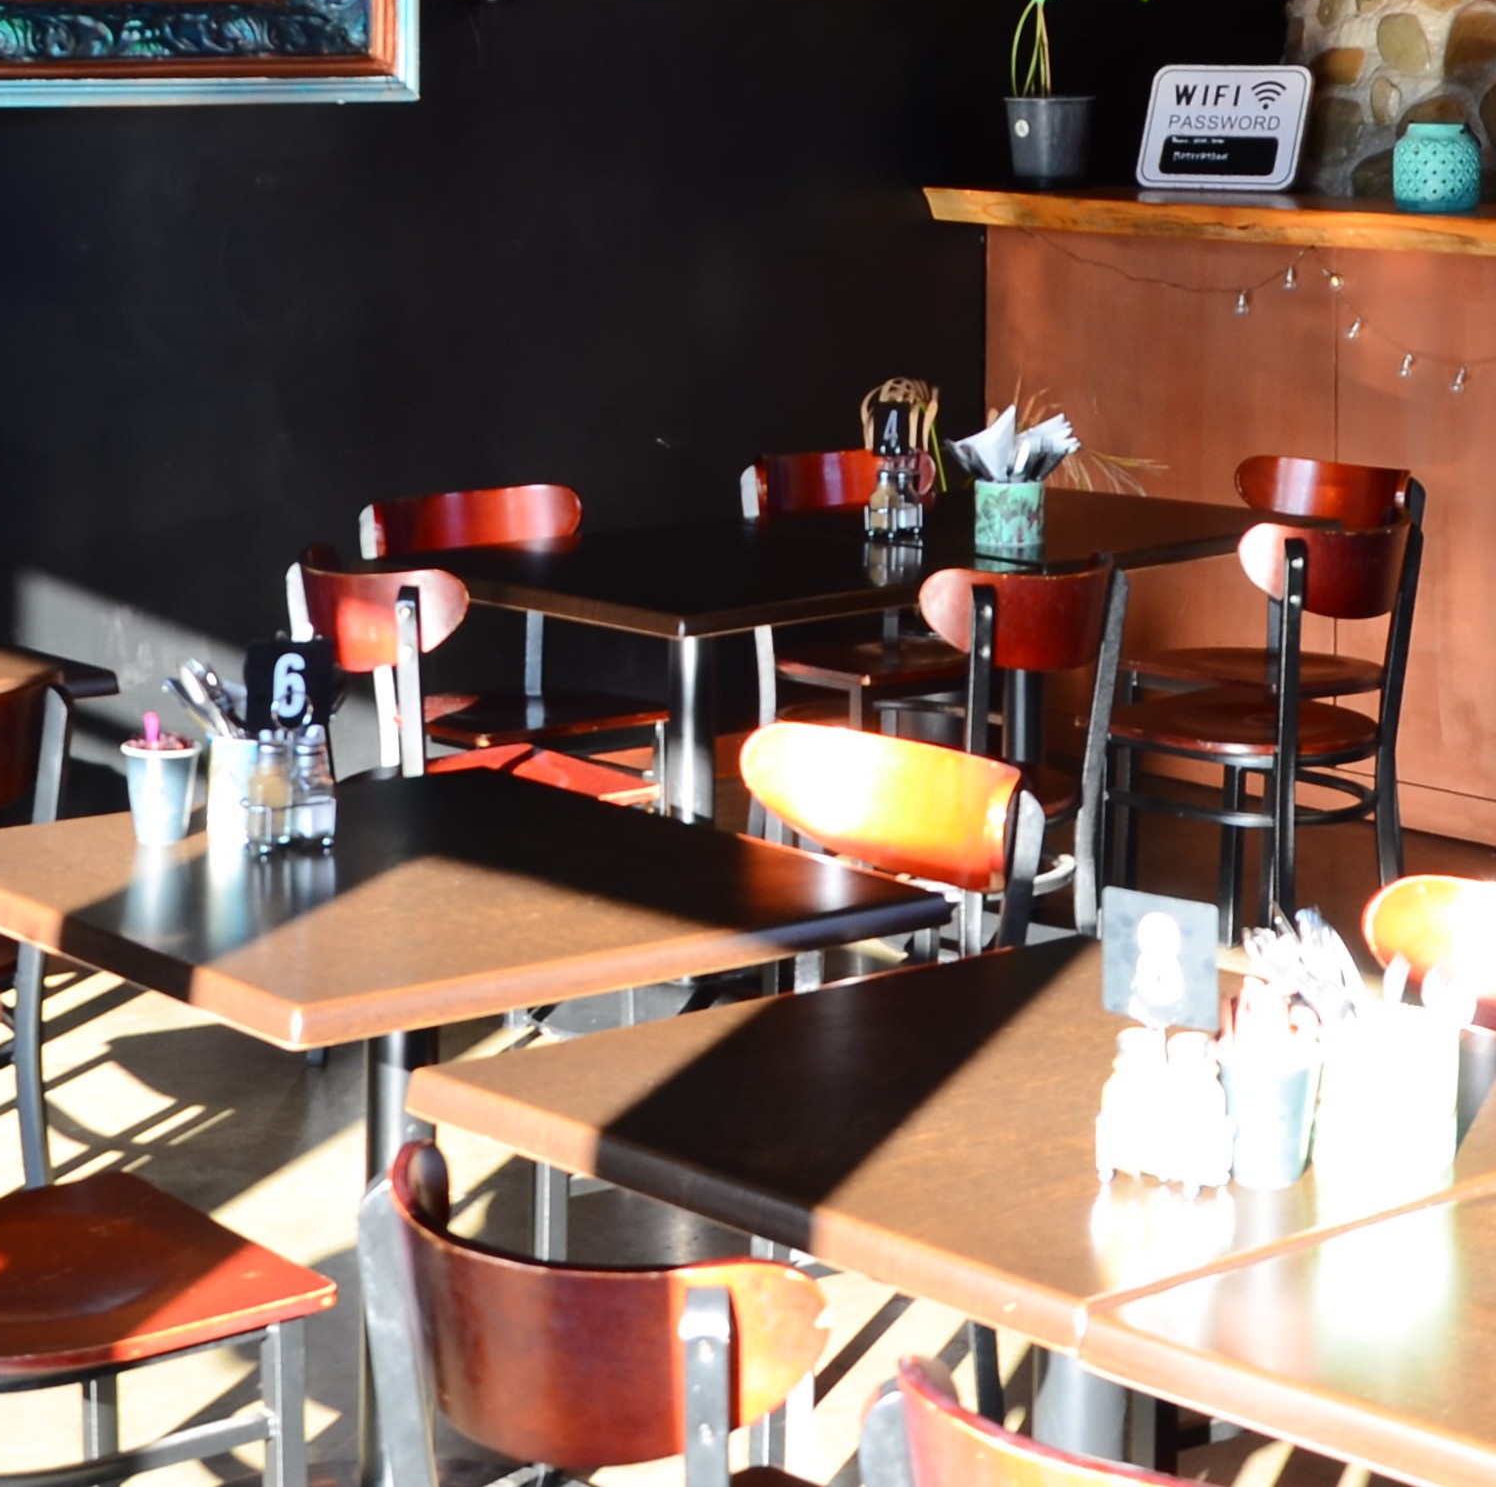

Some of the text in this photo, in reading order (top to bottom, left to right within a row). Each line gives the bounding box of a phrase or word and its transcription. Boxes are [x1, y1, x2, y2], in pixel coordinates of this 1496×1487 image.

[1175, 83, 1241, 107] WIFI
[1168, 114, 1281, 131] PASSWORD
[883, 409, 899, 447] 4
[272, 652, 306, 718] 6
